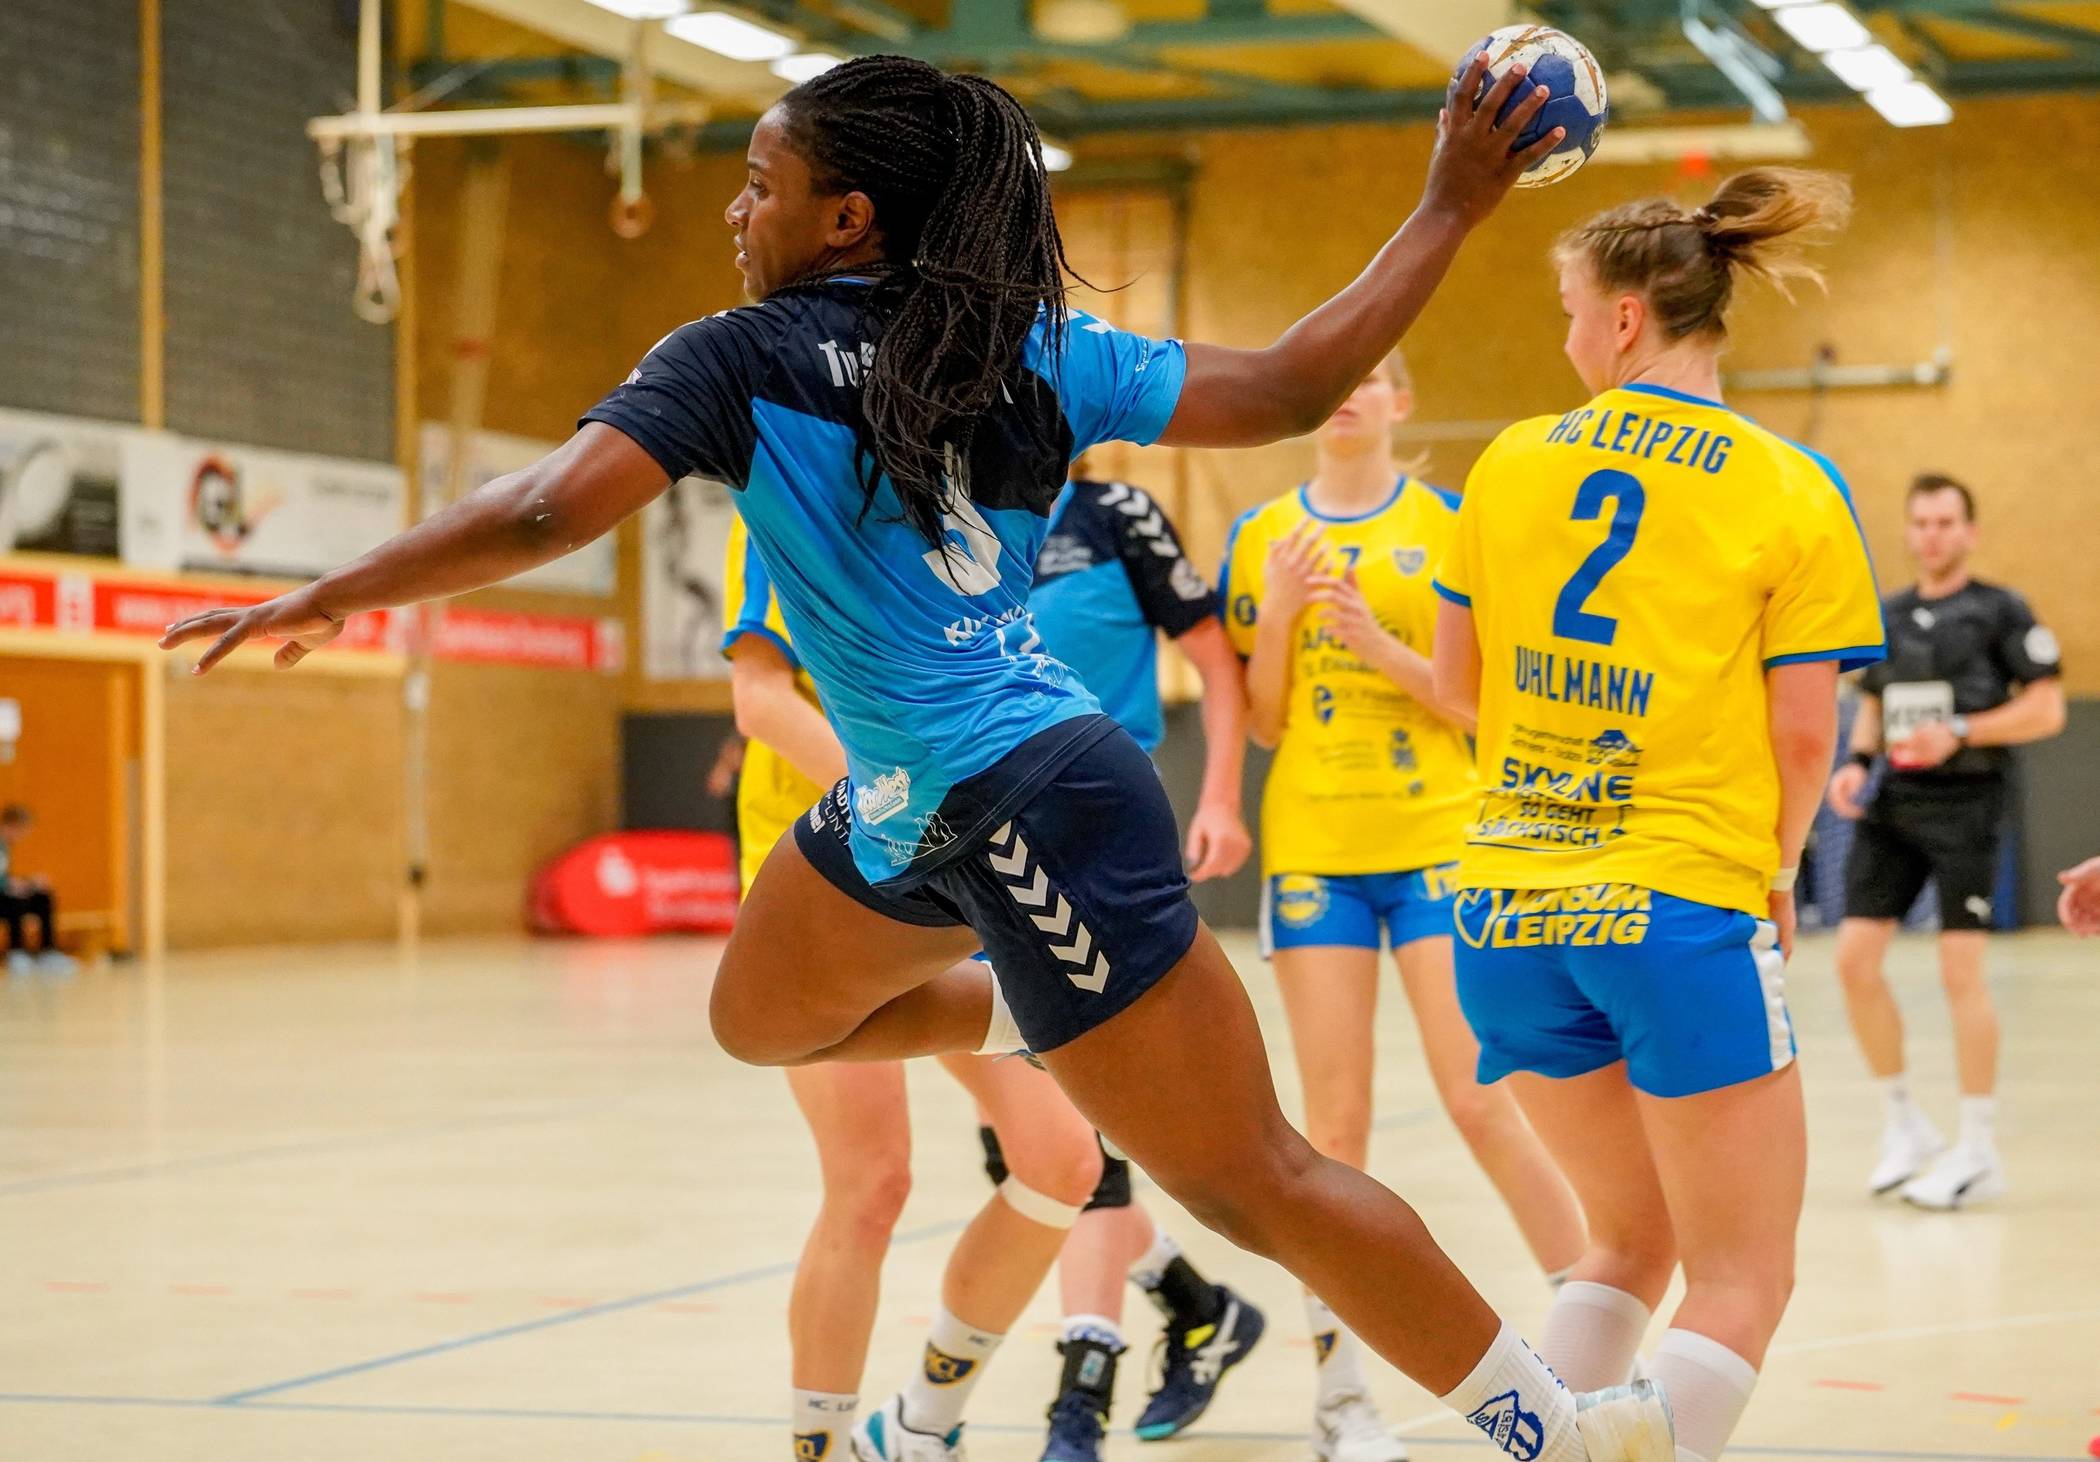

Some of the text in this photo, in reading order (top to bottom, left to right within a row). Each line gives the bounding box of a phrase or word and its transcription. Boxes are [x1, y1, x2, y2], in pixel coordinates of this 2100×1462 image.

[1547, 408, 1734, 474] HC LEIPZIG
[1553, 468, 1646, 647] 2
[1515, 645, 1655, 718] UHLMANN
[1519, 801, 1597, 823] SO GEHT
[1491, 912, 1651, 949] LEIPZIG
